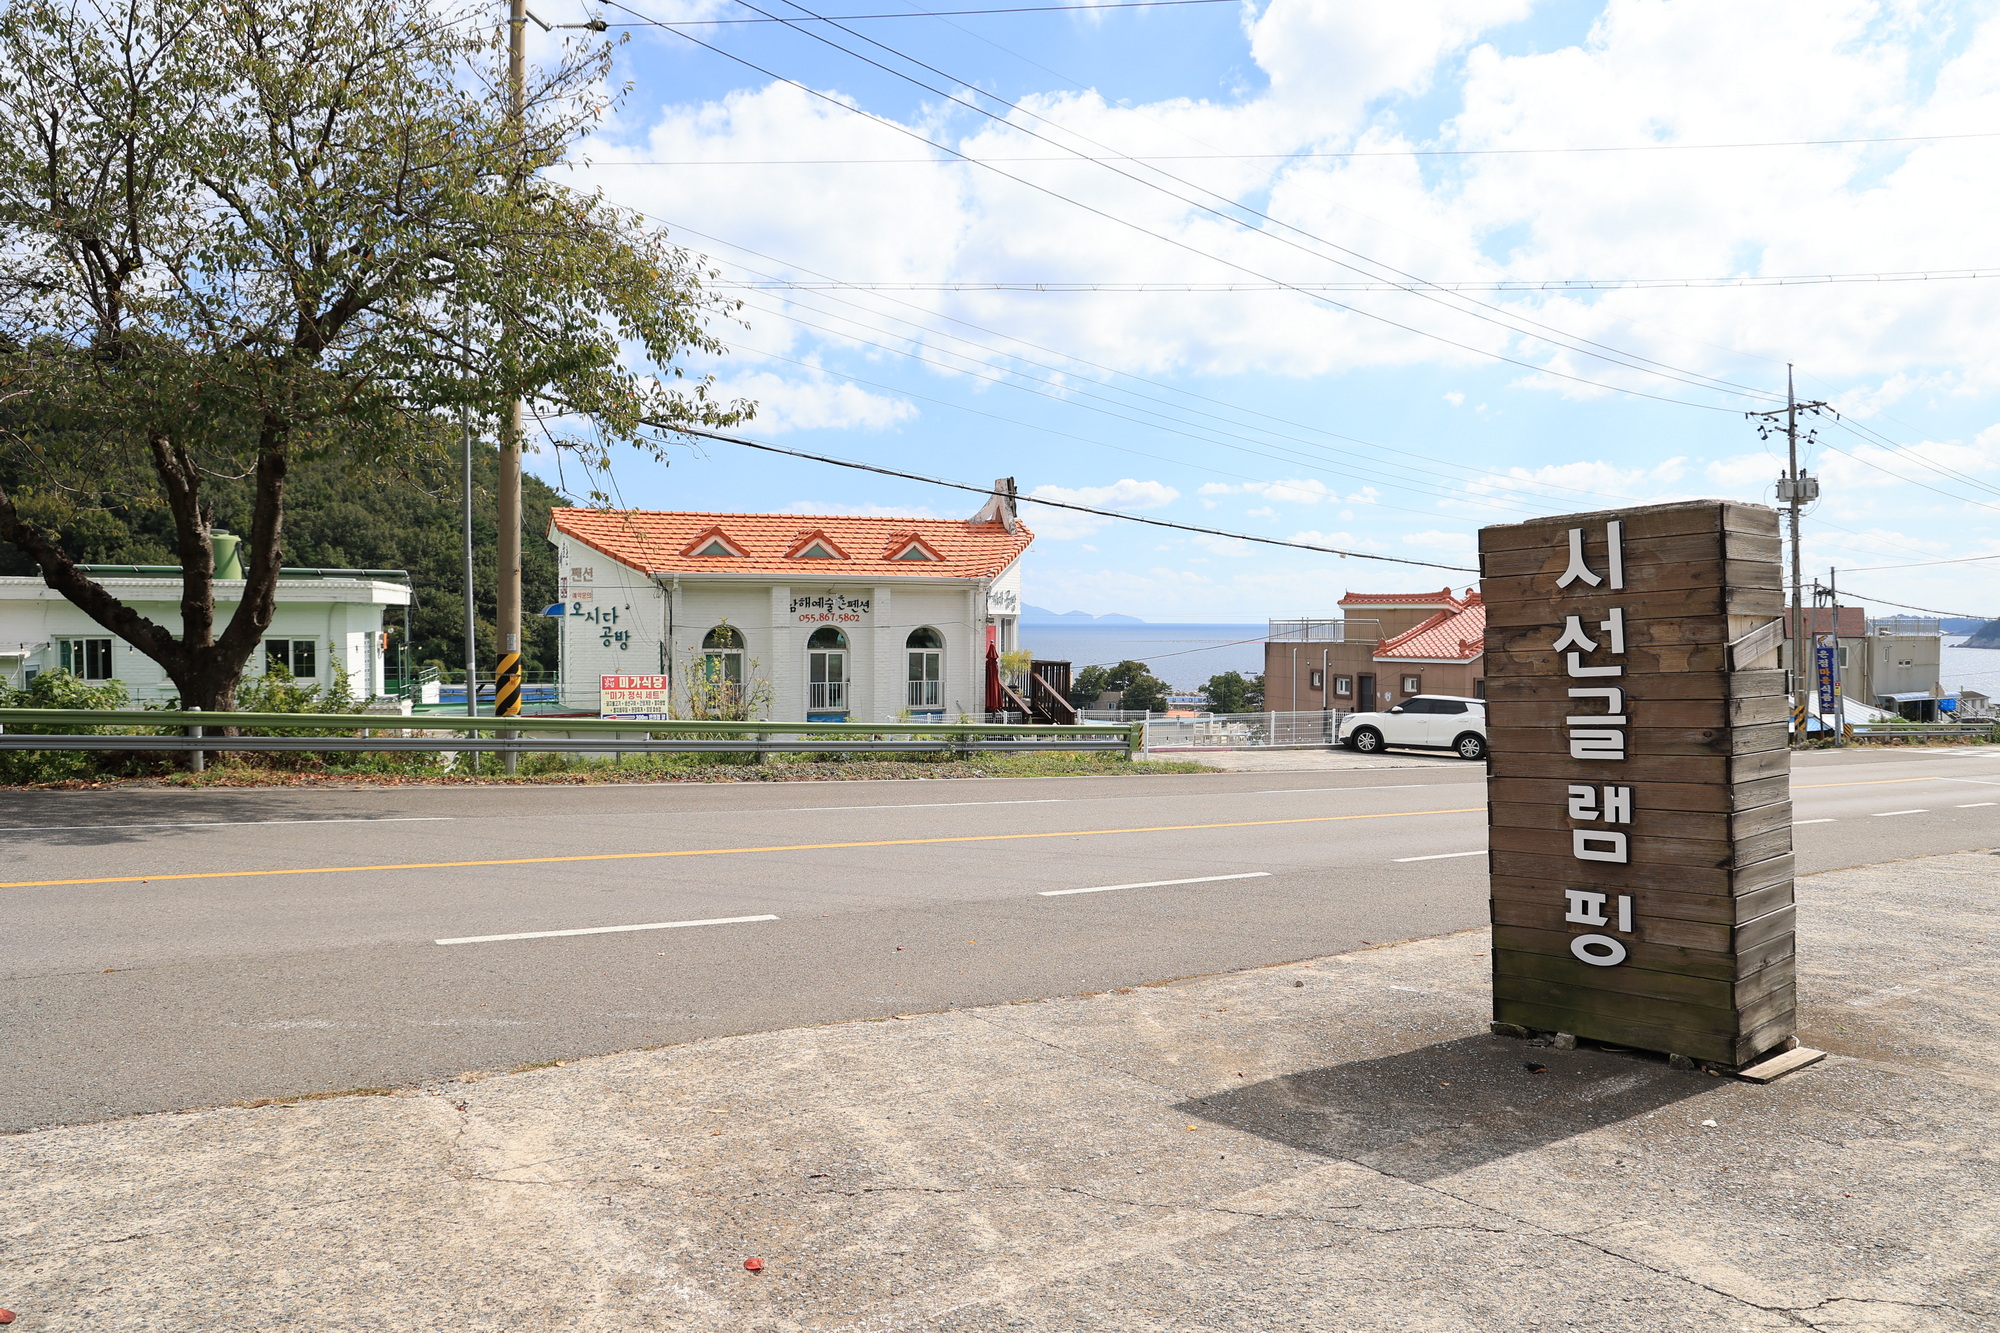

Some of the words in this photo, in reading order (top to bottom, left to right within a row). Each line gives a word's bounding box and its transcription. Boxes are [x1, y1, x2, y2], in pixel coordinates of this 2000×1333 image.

[569, 601, 619, 625] 오시다
[799, 613, 860, 624] 055.867.5802
[599, 626, 631, 651] 공방
[619, 676, 664, 689] 미가식당
[628, 691, 643, 700] 정식
[1552, 520, 1634, 968] 시선글램핑
